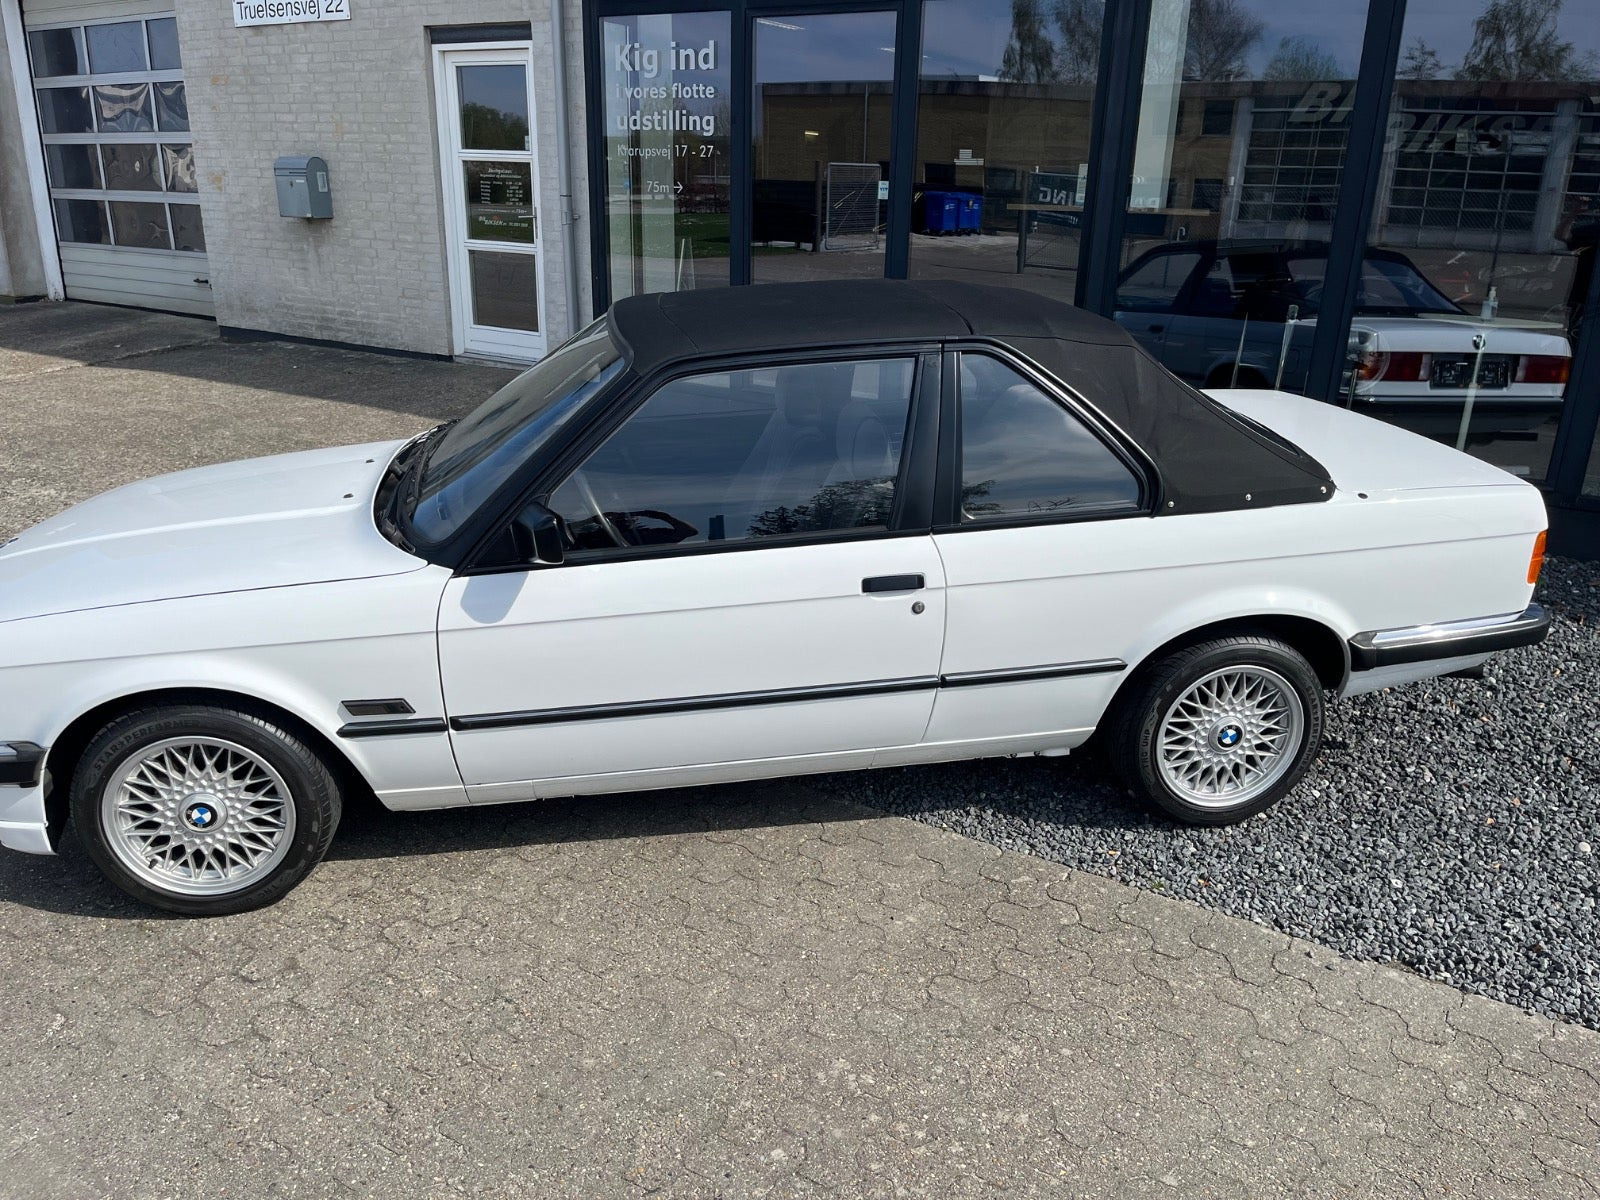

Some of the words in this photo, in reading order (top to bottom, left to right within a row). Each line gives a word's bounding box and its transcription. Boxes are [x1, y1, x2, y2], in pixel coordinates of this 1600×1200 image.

[236, 0, 321, 20] Truelsensvej
[325, 0, 344, 13] 22
[615, 43, 657, 78] Kig
[671, 40, 715, 70] ind
[625, 85, 667, 99] vores
[672, 83, 715, 99] flotte
[617, 110, 715, 136] udstilling
[617, 144, 671, 159] Krarupsvej
[675, 145, 687, 157] 17
[700, 145, 714, 157] 27
[647, 181, 669, 193] 75m
